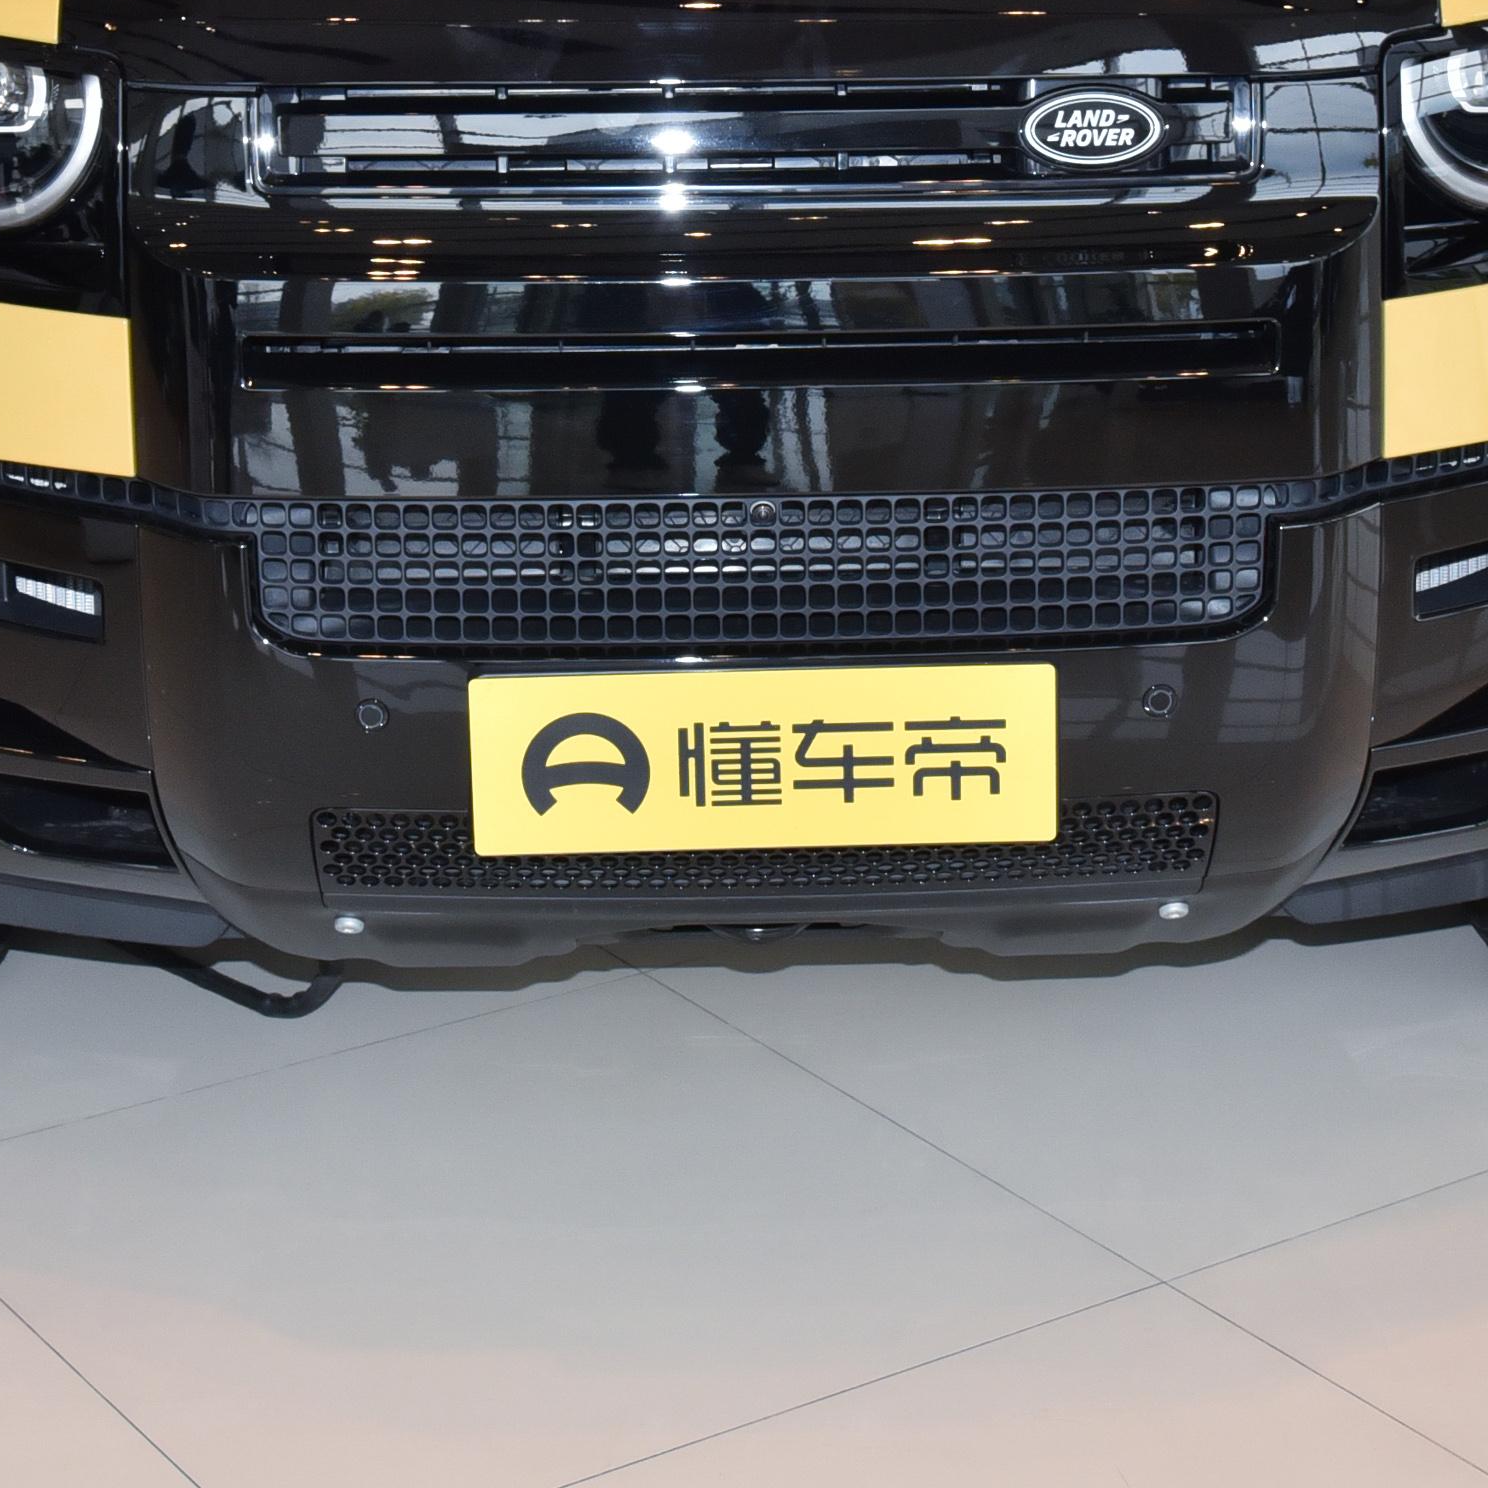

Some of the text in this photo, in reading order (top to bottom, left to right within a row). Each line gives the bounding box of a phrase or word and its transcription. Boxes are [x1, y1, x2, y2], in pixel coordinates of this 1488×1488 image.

[1054, 109, 1116, 129] LAND
[1059, 128, 1135, 147] ROVER
[677, 715, 1007, 808] 懂车帝
